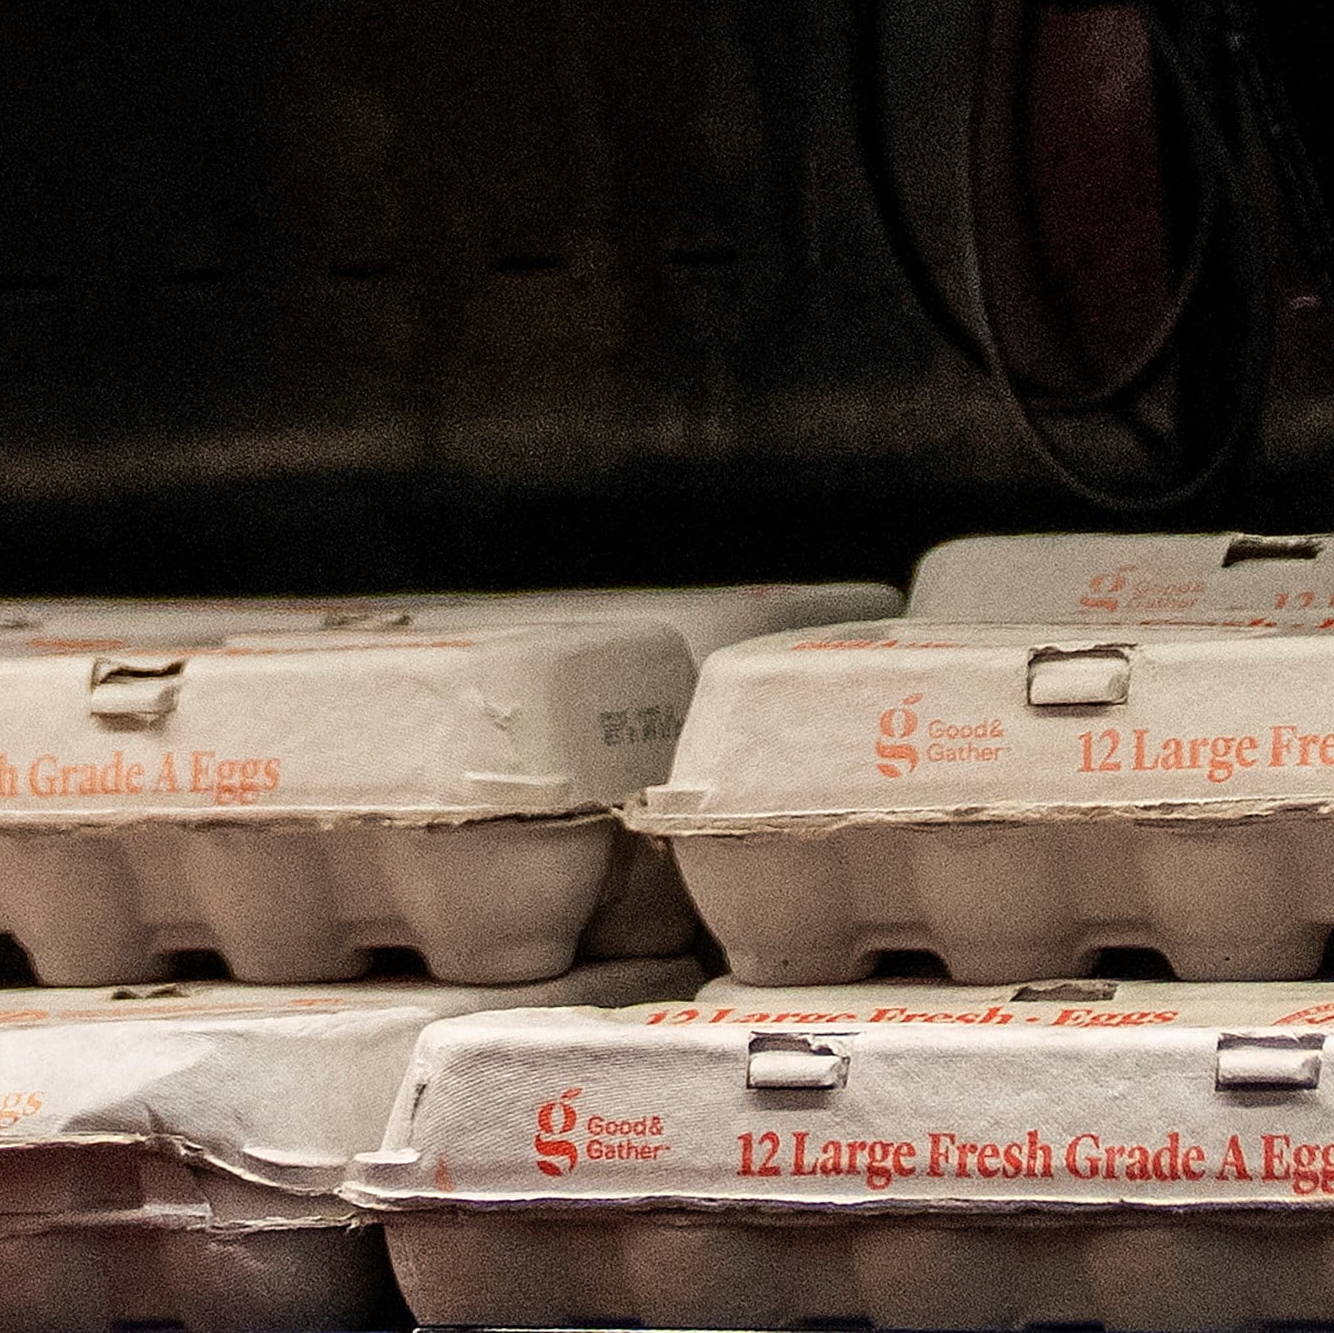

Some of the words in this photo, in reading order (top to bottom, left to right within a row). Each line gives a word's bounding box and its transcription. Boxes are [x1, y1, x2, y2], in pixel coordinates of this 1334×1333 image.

[928, 719, 1005, 739] Good&
[926, 743, 1004, 764] Gather
[1077, 728, 1121, 773] 12
[1132, 728, 1259, 783] Large
[27, 750, 144, 798] Grade
[153, 751, 179, 794] A
[190, 750, 281, 806] Eggs
[869, 1006, 1015, 1025] Fresh
[587, 1115, 665, 1137] Good&
[586, 1139, 663, 1161] Gather
[737, 1130, 783, 1177] 12
[790, 1130, 917, 1191] Large
[926, 1129, 1055, 1180] Fresh
[1065, 1132, 1206, 1182] Grade
[1215, 1133, 1254, 1182] A
